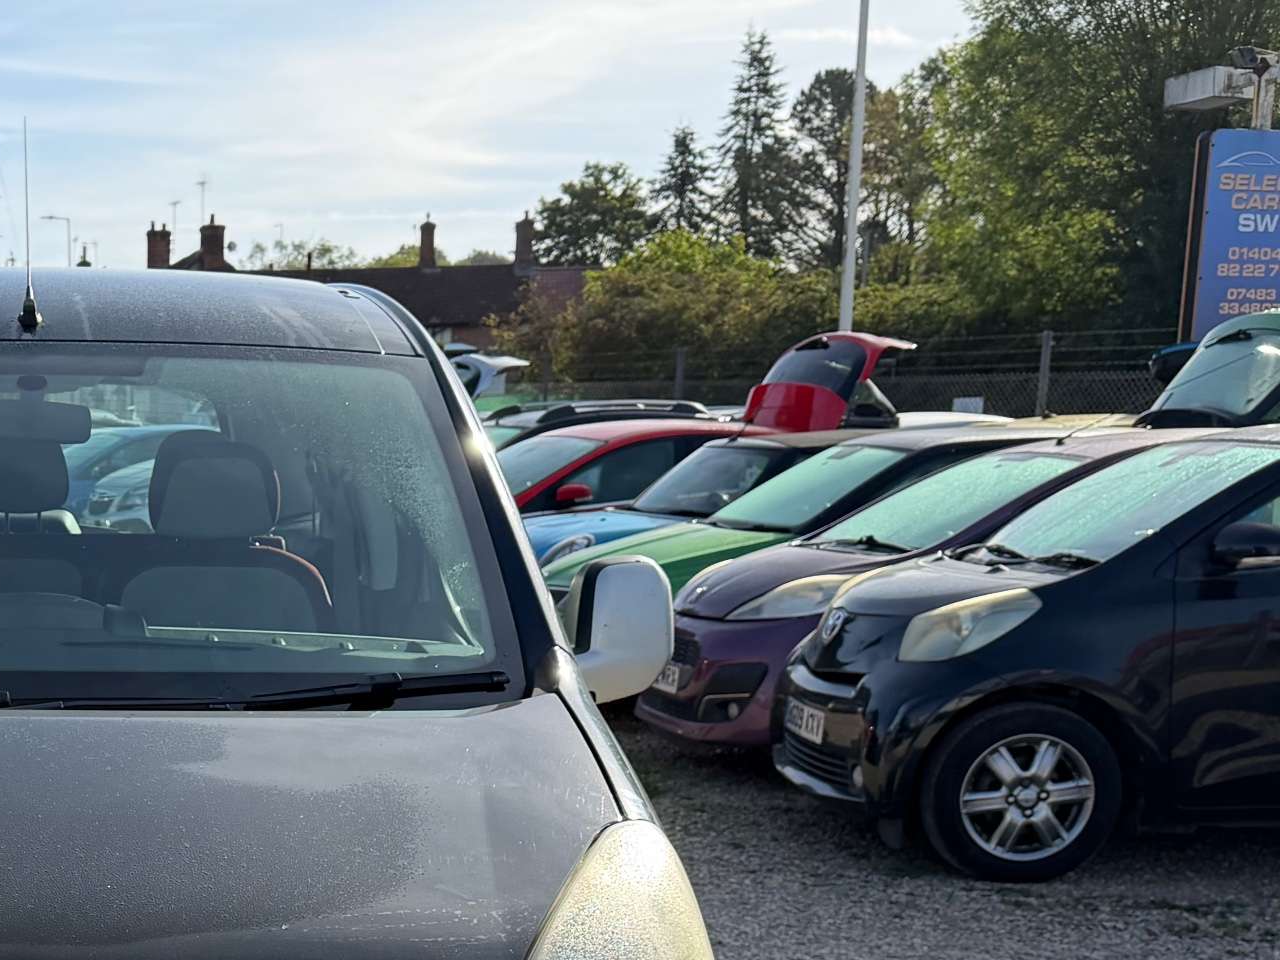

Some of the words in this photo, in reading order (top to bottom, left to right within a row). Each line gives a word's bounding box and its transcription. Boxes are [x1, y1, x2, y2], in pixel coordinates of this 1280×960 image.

[1219, 172, 1280, 191] SELE
[1238, 213, 1280, 232] SW
[1228, 246, 1280, 260] 01404
[1216, 263, 1240, 277] 82
[1242, 263, 1265, 277] 22
[1227, 288, 1276, 300] 07483
